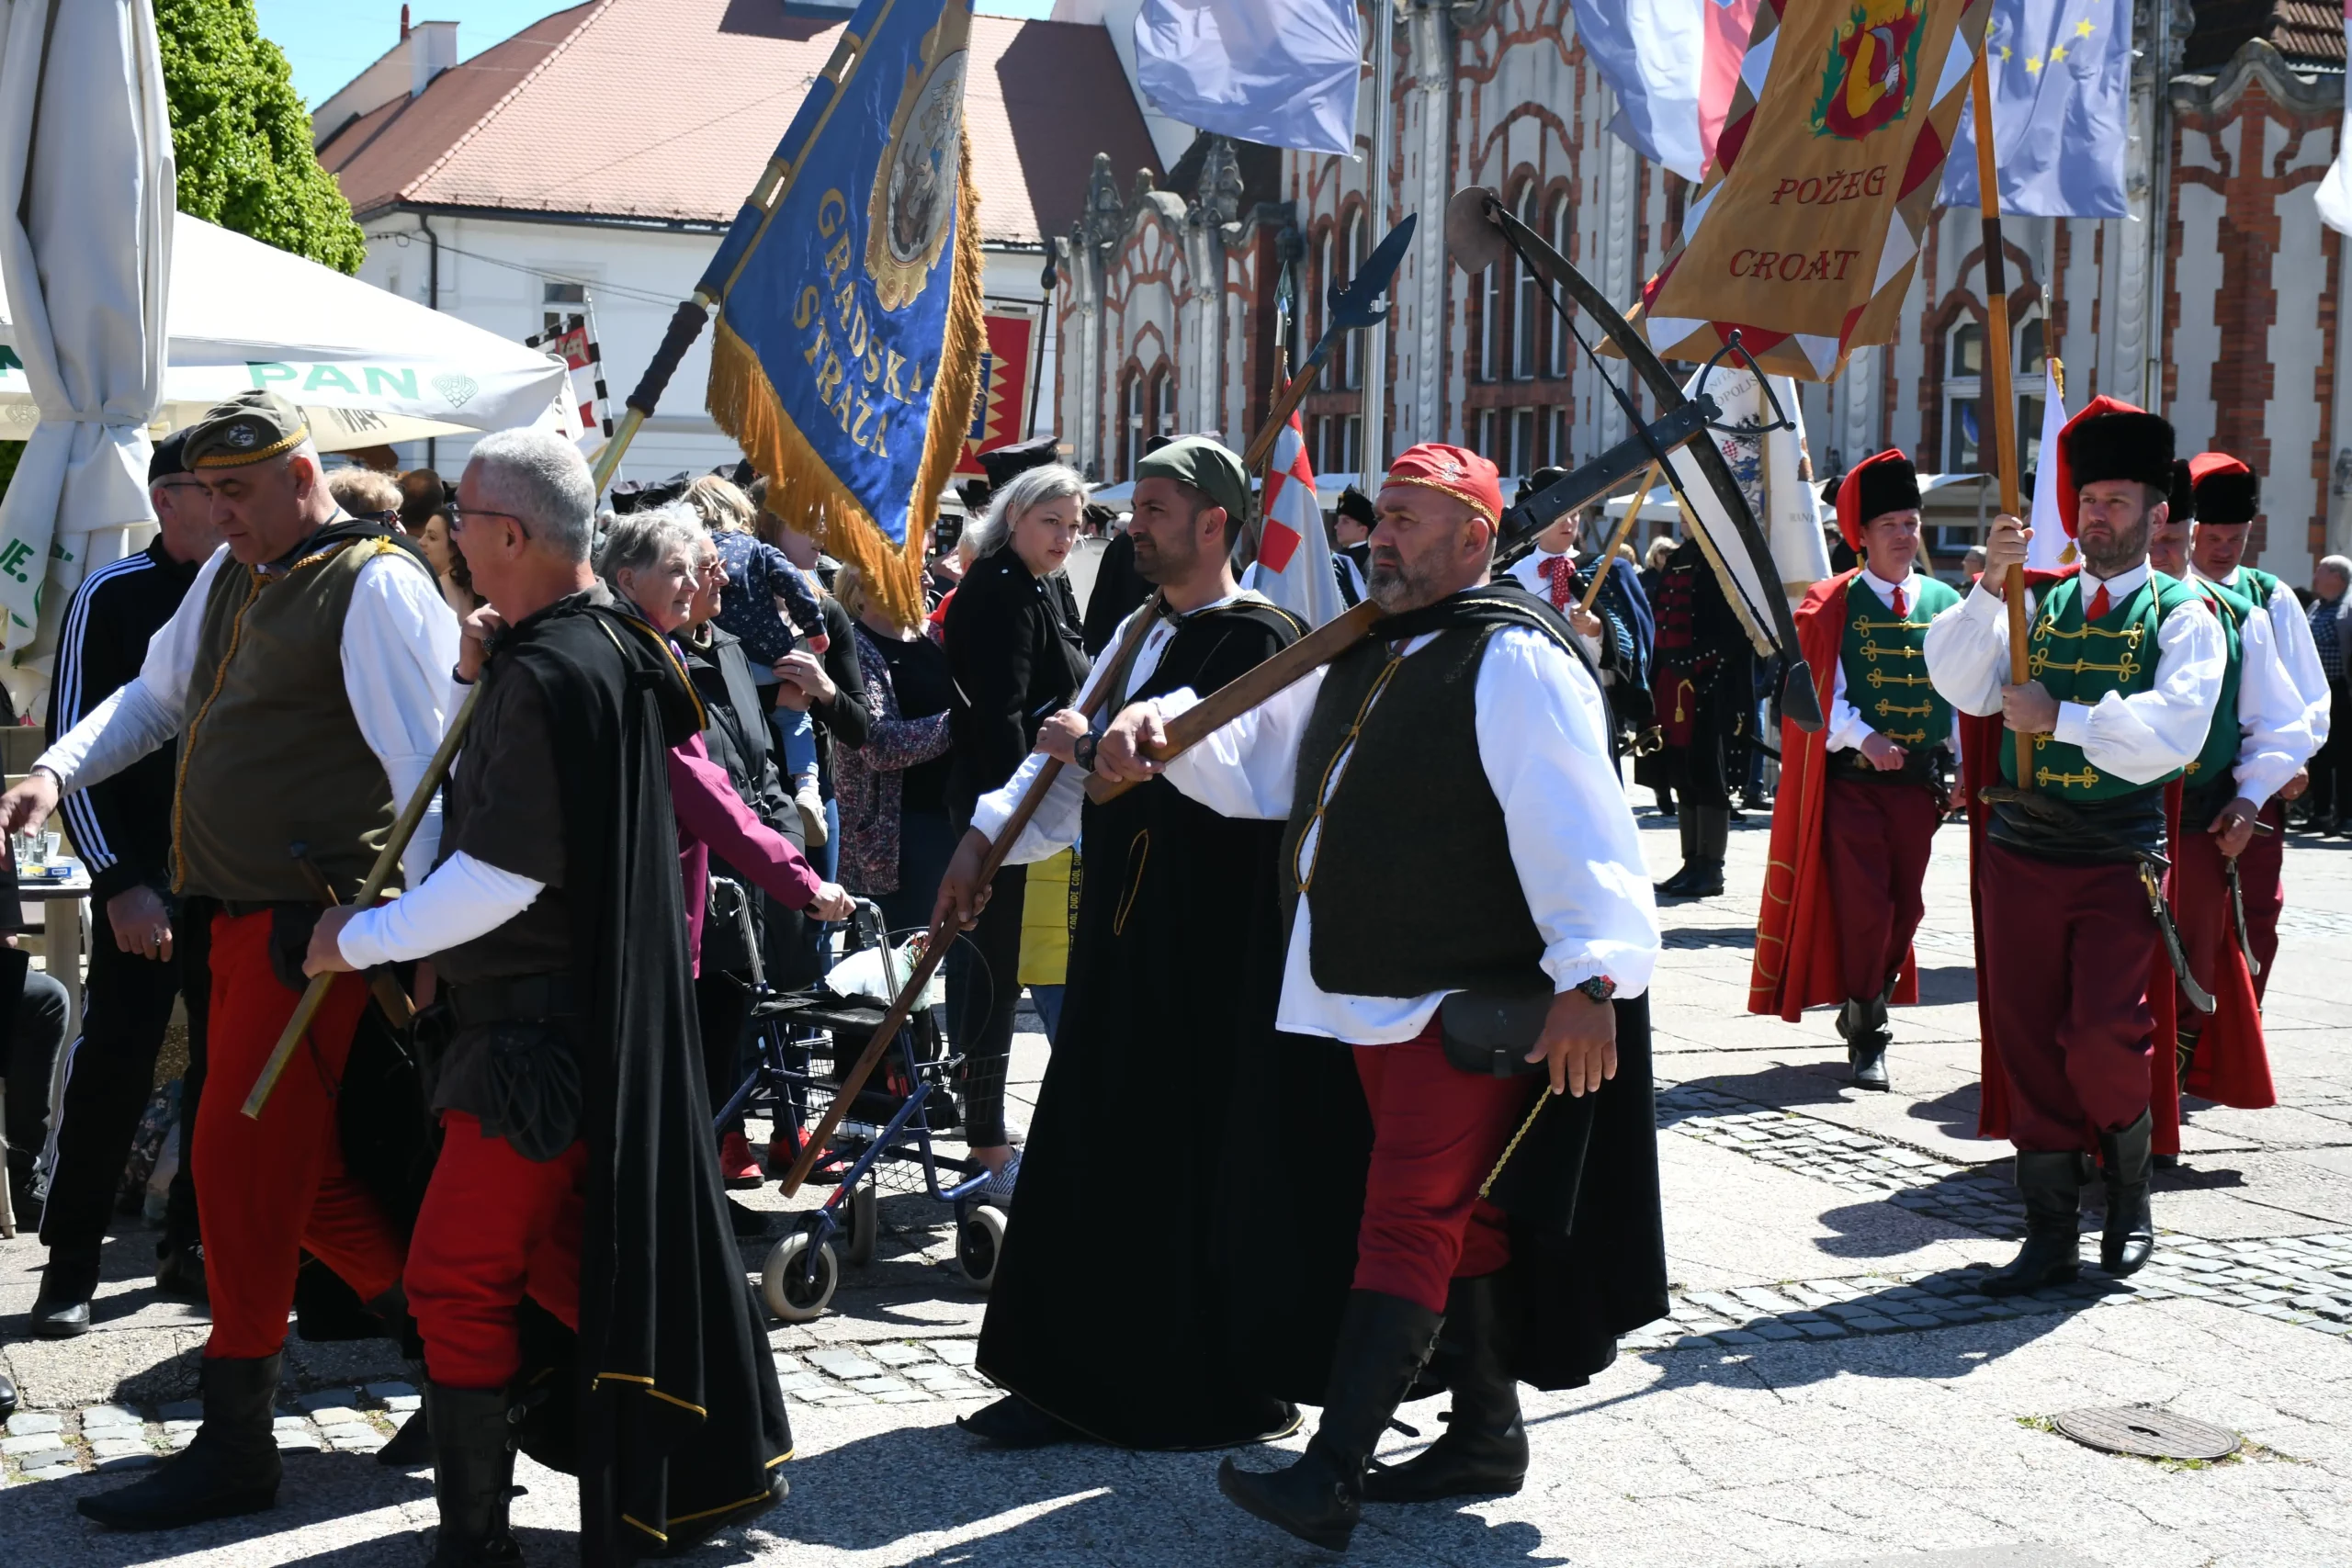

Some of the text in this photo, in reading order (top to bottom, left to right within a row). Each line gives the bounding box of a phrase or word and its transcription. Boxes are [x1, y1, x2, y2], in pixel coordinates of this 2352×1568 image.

[1770, 164, 1888, 206] POŽEG
[1728, 248, 1861, 282] CROAT
[817, 187, 922, 405] GRADSKA
[245, 361, 422, 400] PAN
[794, 285, 889, 459] STRAŽA
[1071, 868, 1080, 886] COOL
[1070, 891, 1080, 908] DUDE
[1069, 911, 1079, 930] COOL
